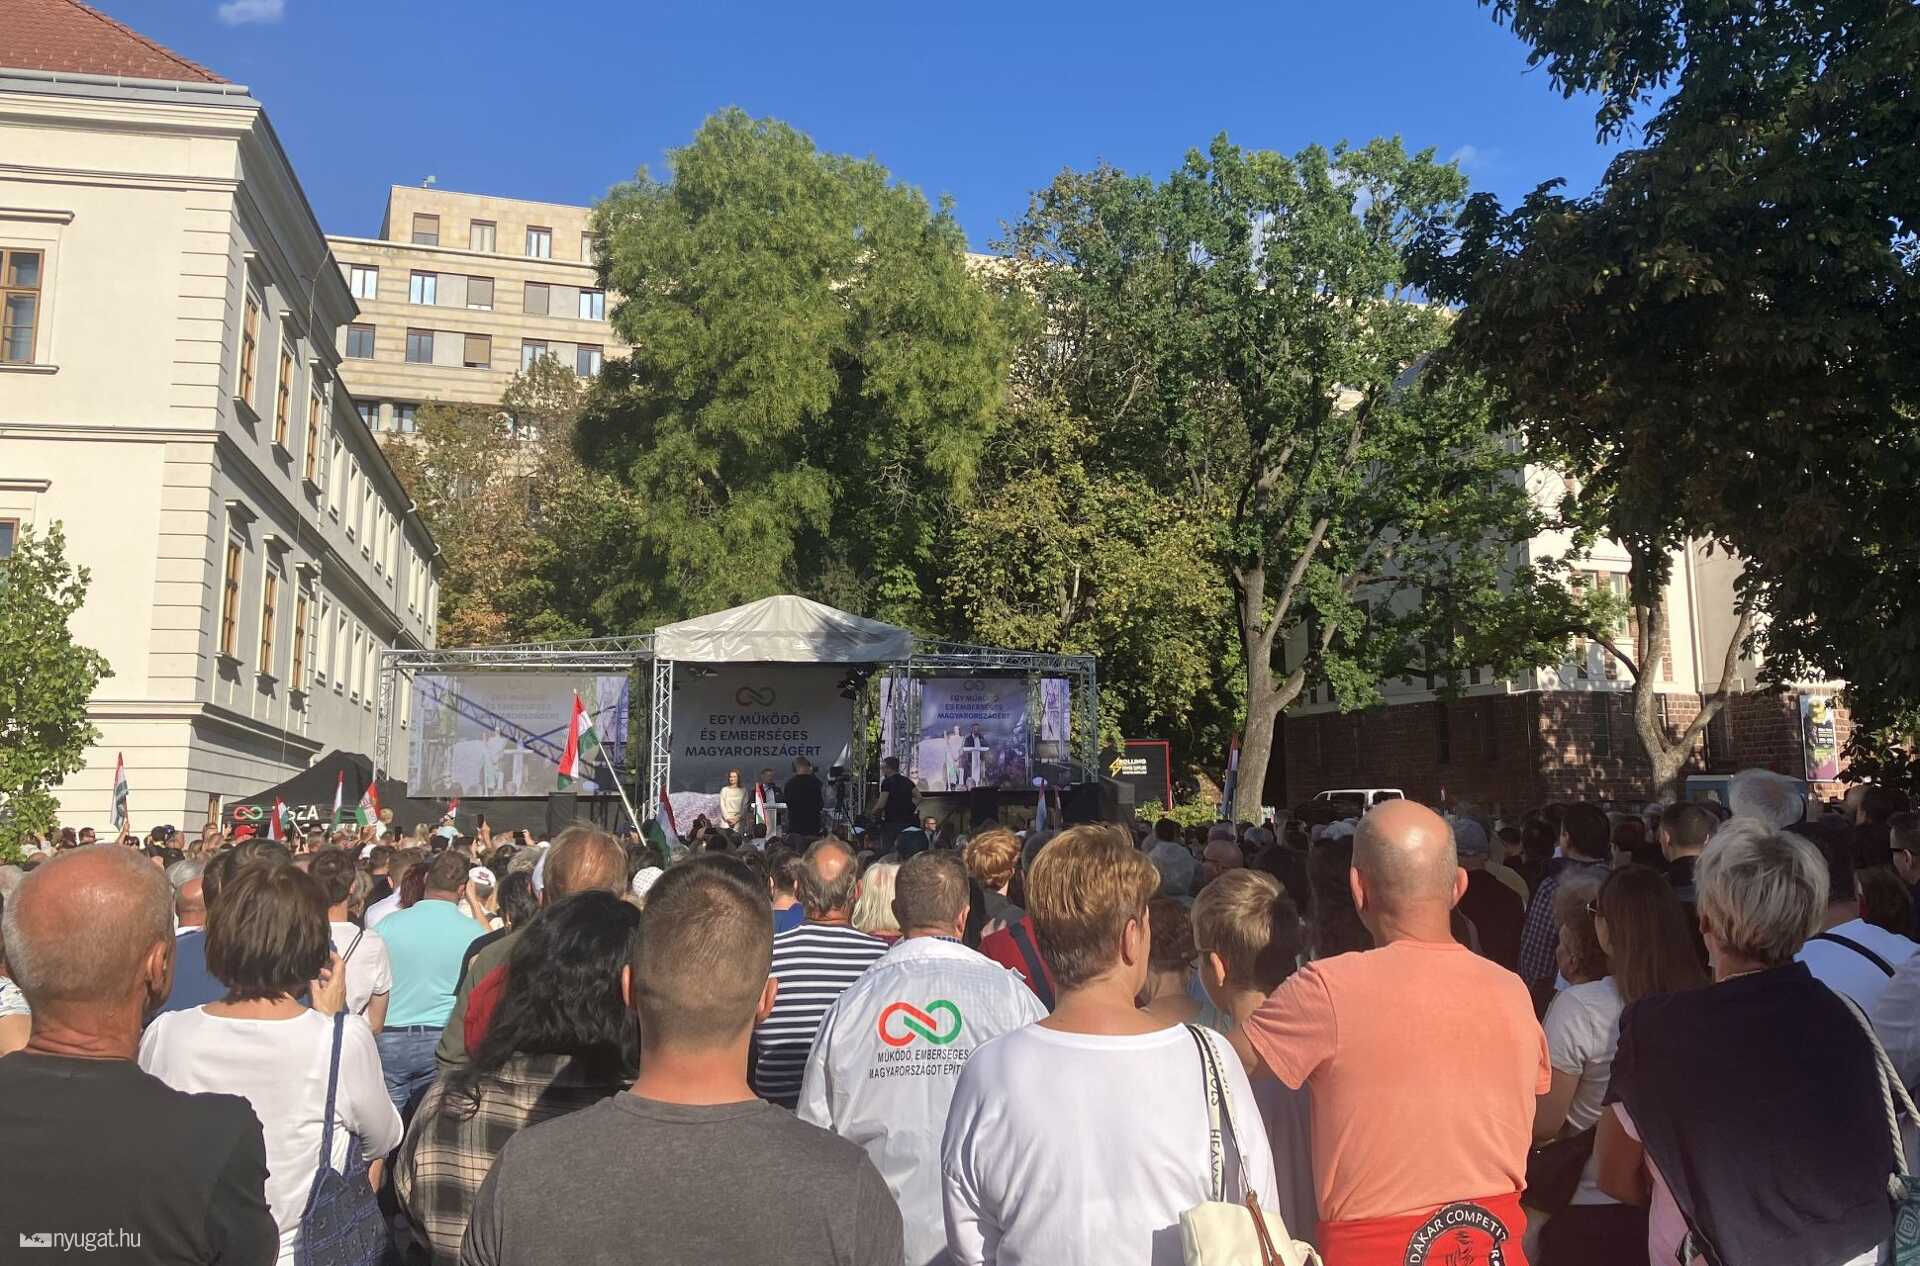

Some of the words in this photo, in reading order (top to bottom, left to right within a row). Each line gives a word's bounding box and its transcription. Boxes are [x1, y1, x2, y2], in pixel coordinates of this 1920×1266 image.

[709, 714, 736, 725] EGY
[740, 711, 800, 725] MŰKÖDŐ
[700, 727, 716, 740] ÉS
[720, 728, 808, 741] EMBERSÉGES
[685, 743, 821, 757] MAGYARORSZÁGÉRT
[1409, 1218, 1444, 1263] DAKAR
